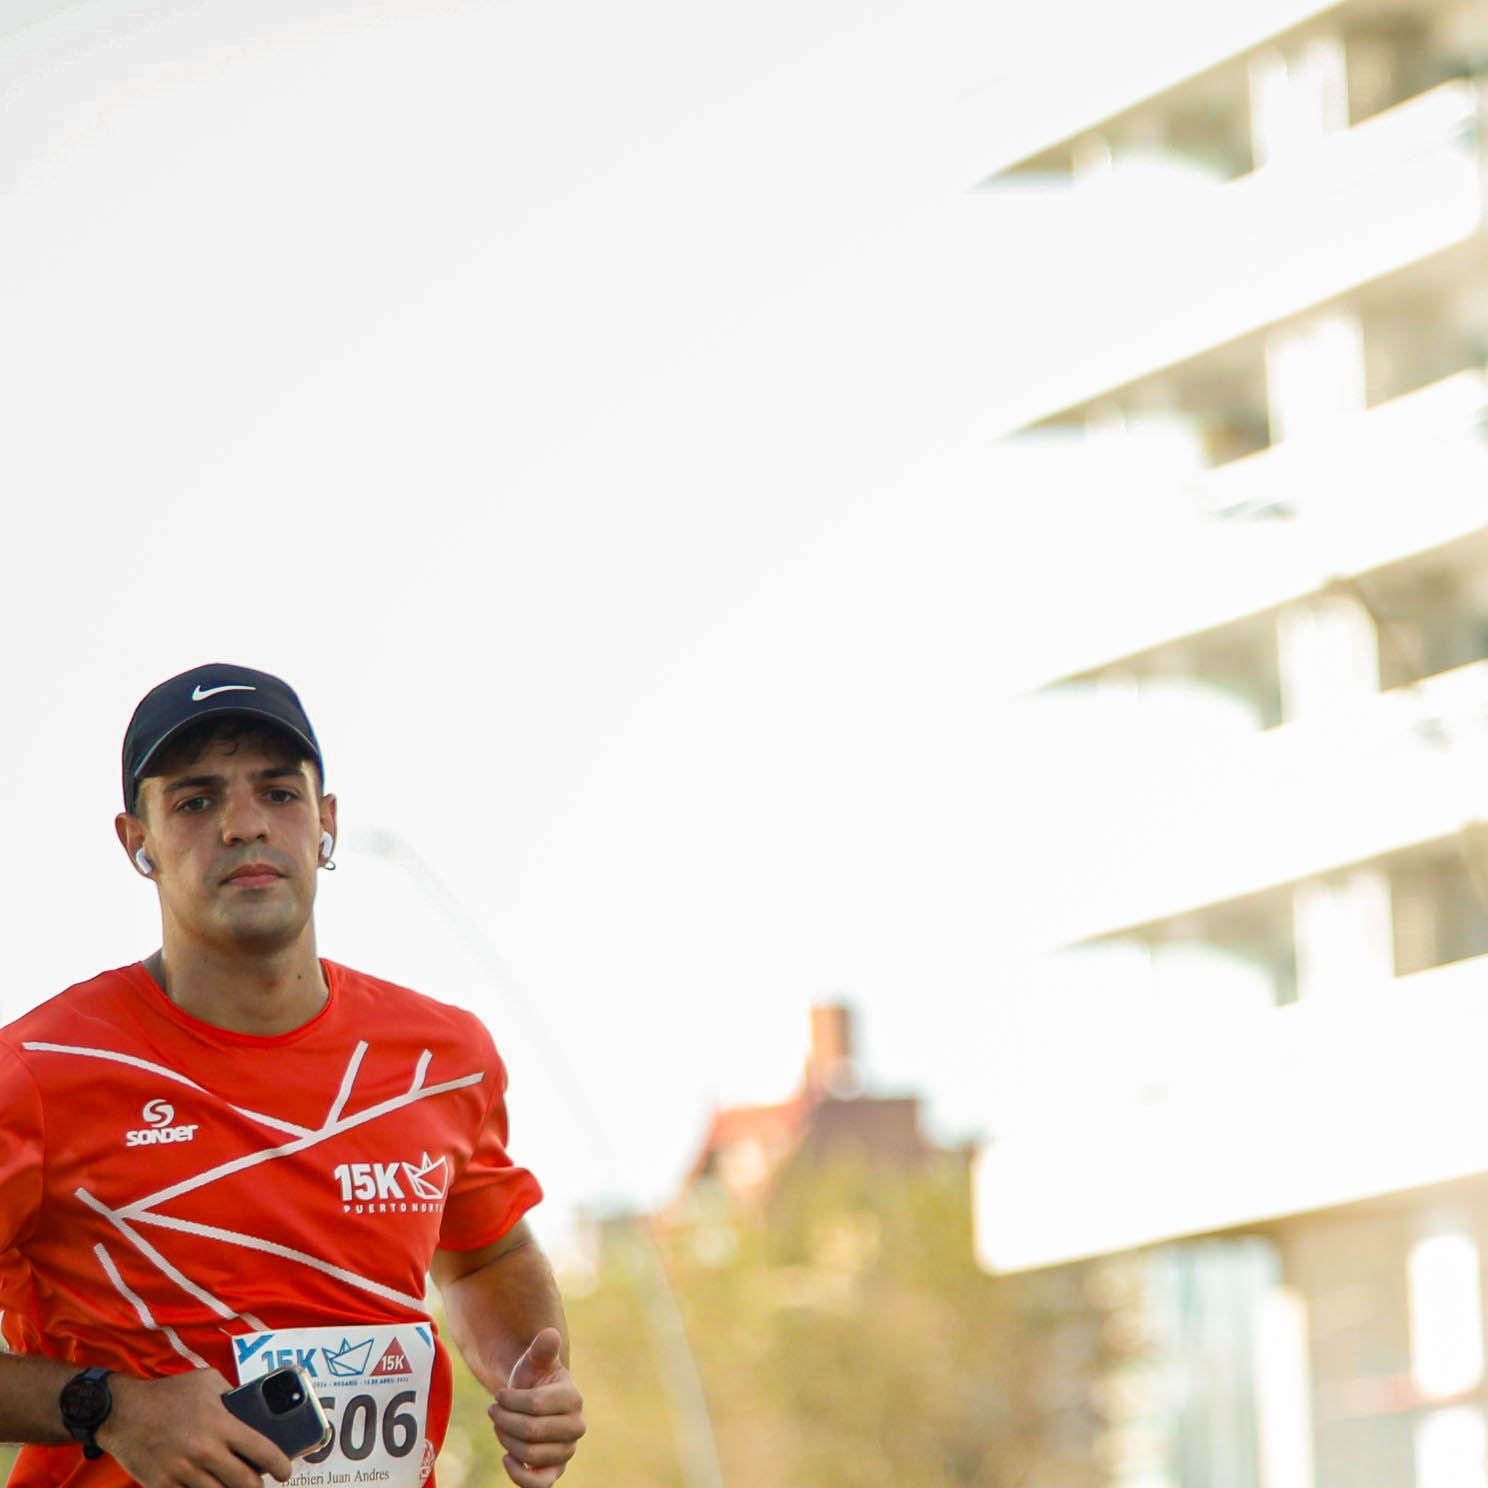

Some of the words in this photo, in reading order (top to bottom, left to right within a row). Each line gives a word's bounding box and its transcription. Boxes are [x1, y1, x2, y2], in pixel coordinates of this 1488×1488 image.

[334, 1162, 405, 1201] 15K
[381, 1354, 405, 1371] 15K
[327, 1471, 351, 1485] Juan
[354, 1468, 390, 1483] Andres
